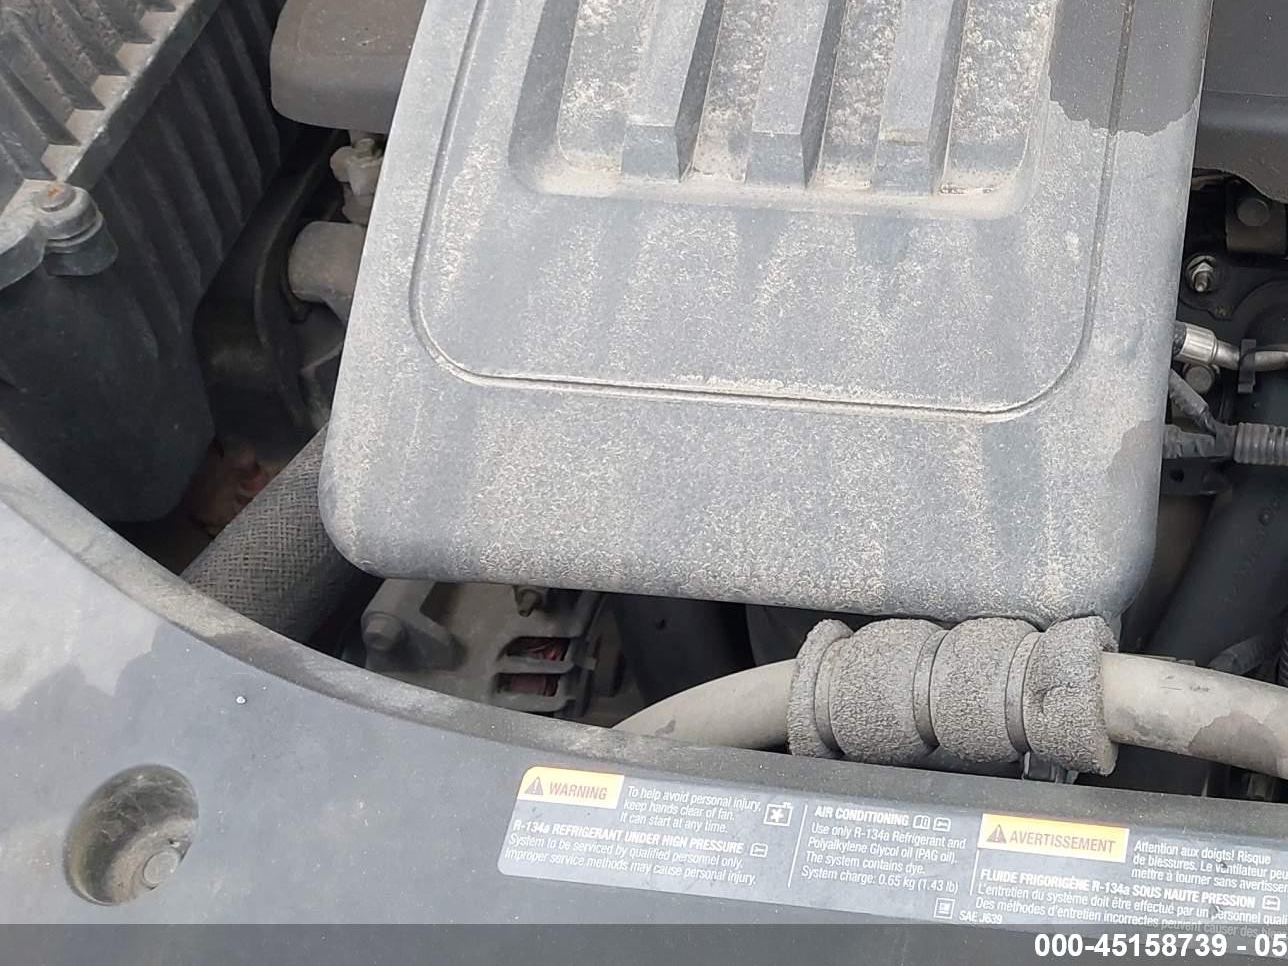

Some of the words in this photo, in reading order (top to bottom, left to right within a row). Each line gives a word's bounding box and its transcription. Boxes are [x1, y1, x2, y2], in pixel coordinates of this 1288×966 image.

[549, 783, 607, 799] WARNING
[627, 786, 639, 796] To
[640, 788, 661, 801] help
[664, 792, 688, 802] avoid
[691, 795, 730, 807] personal
[734, 799, 762, 811] injury.
[625, 801, 648, 811] keep
[651, 803, 678, 813] hands
[681, 807, 703, 816] clear
[707, 809, 715, 818] of
[719, 811, 735, 820] fan.
[815, 806, 833, 818] AIR
[835, 808, 909, 826] CONDITIONING
[631, 816, 646, 824] can
[650, 816, 670, 826] start
[674, 818, 683, 827] at
[685, 821, 702, 831] any
[705, 822, 728, 833] time.
[812, 823, 830, 834] Use
[831, 826, 851, 838] only
[855, 828, 890, 841] R-134a
[892, 831, 945, 848] Refrigerant
[948, 837, 966, 849] and
[513, 820, 550, 833] R-134a
[553, 824, 622, 841] REFRIGERANT
[625, 831, 660, 844] UNDER
[663, 835, 687, 846] HIGH
[689, 838, 744, 853] PRESSURE
[1010, 831, 1115, 853] AVERTISSEMENT
[510, 834, 545, 848] System
[548, 839, 557, 848] to
[560, 840, 571, 850] be
[574, 841, 613, 853] serviced
[616, 845, 629, 858] by
[630, 846, 670, 860] qualified
[673, 852, 719, 866] personnel
[721, 857, 744, 870] only.
[805, 851, 824, 863] The
[825, 855, 860, 869] system
[863, 858, 903, 872] contains
[906, 863, 926, 876] dye.
[870, 844, 898, 858] Glycol
[901, 847, 913, 858] oil
[916, 849, 939, 862] (PAG
[1134, 854, 1146, 865] de
[1149, 856, 1199, 870] blessures.
[1201, 862, 1212, 872] Le
[1135, 841, 1178, 855] Attention
[1181, 848, 1199, 857] aux
[1202, 848, 1235, 862] doigts!
[1236, 851, 1271, 866] Risque
[506, 849, 546, 863] Improper
[550, 854, 584, 865] service
[587, 857, 628, 870] methods
[630, 863, 651, 874] may
[654, 866, 683, 876] cause
[685, 867, 726, 881] personal
[728, 872, 757, 886] injury.
[1132, 868, 1164, 879] mettre
[1177, 872, 1211, 885] tourner
[1215, 877, 1237, 887] sans
[802, 866, 838, 881] System
[840, 870, 875, 885] charge:
[879, 874, 901, 885] 0.65
[904, 877, 916, 890] kg
[918, 878, 944, 891] (1.43
[945, 882, 960, 895] lb)
[981, 869, 1018, 883] FLUIDE
[1093, 880, 1130, 895] R-134a
[1133, 884, 1161, 898] SOUS
[1166, 888, 1200, 902] HAUTE
[1202, 892, 1254, 907] PRESSION
[977, 898, 994, 909] Des
[998, 899, 1045, 914] méthodes
[1032, 889, 1044, 900] du
[1091, 895, 1109, 907] doit
[1113, 897, 1131, 909] être
[1178, 907, 1194, 918] par
[1197, 909, 1208, 917] un
[960, 910, 977, 922] SAE
[979, 912, 1002, 924] J639
